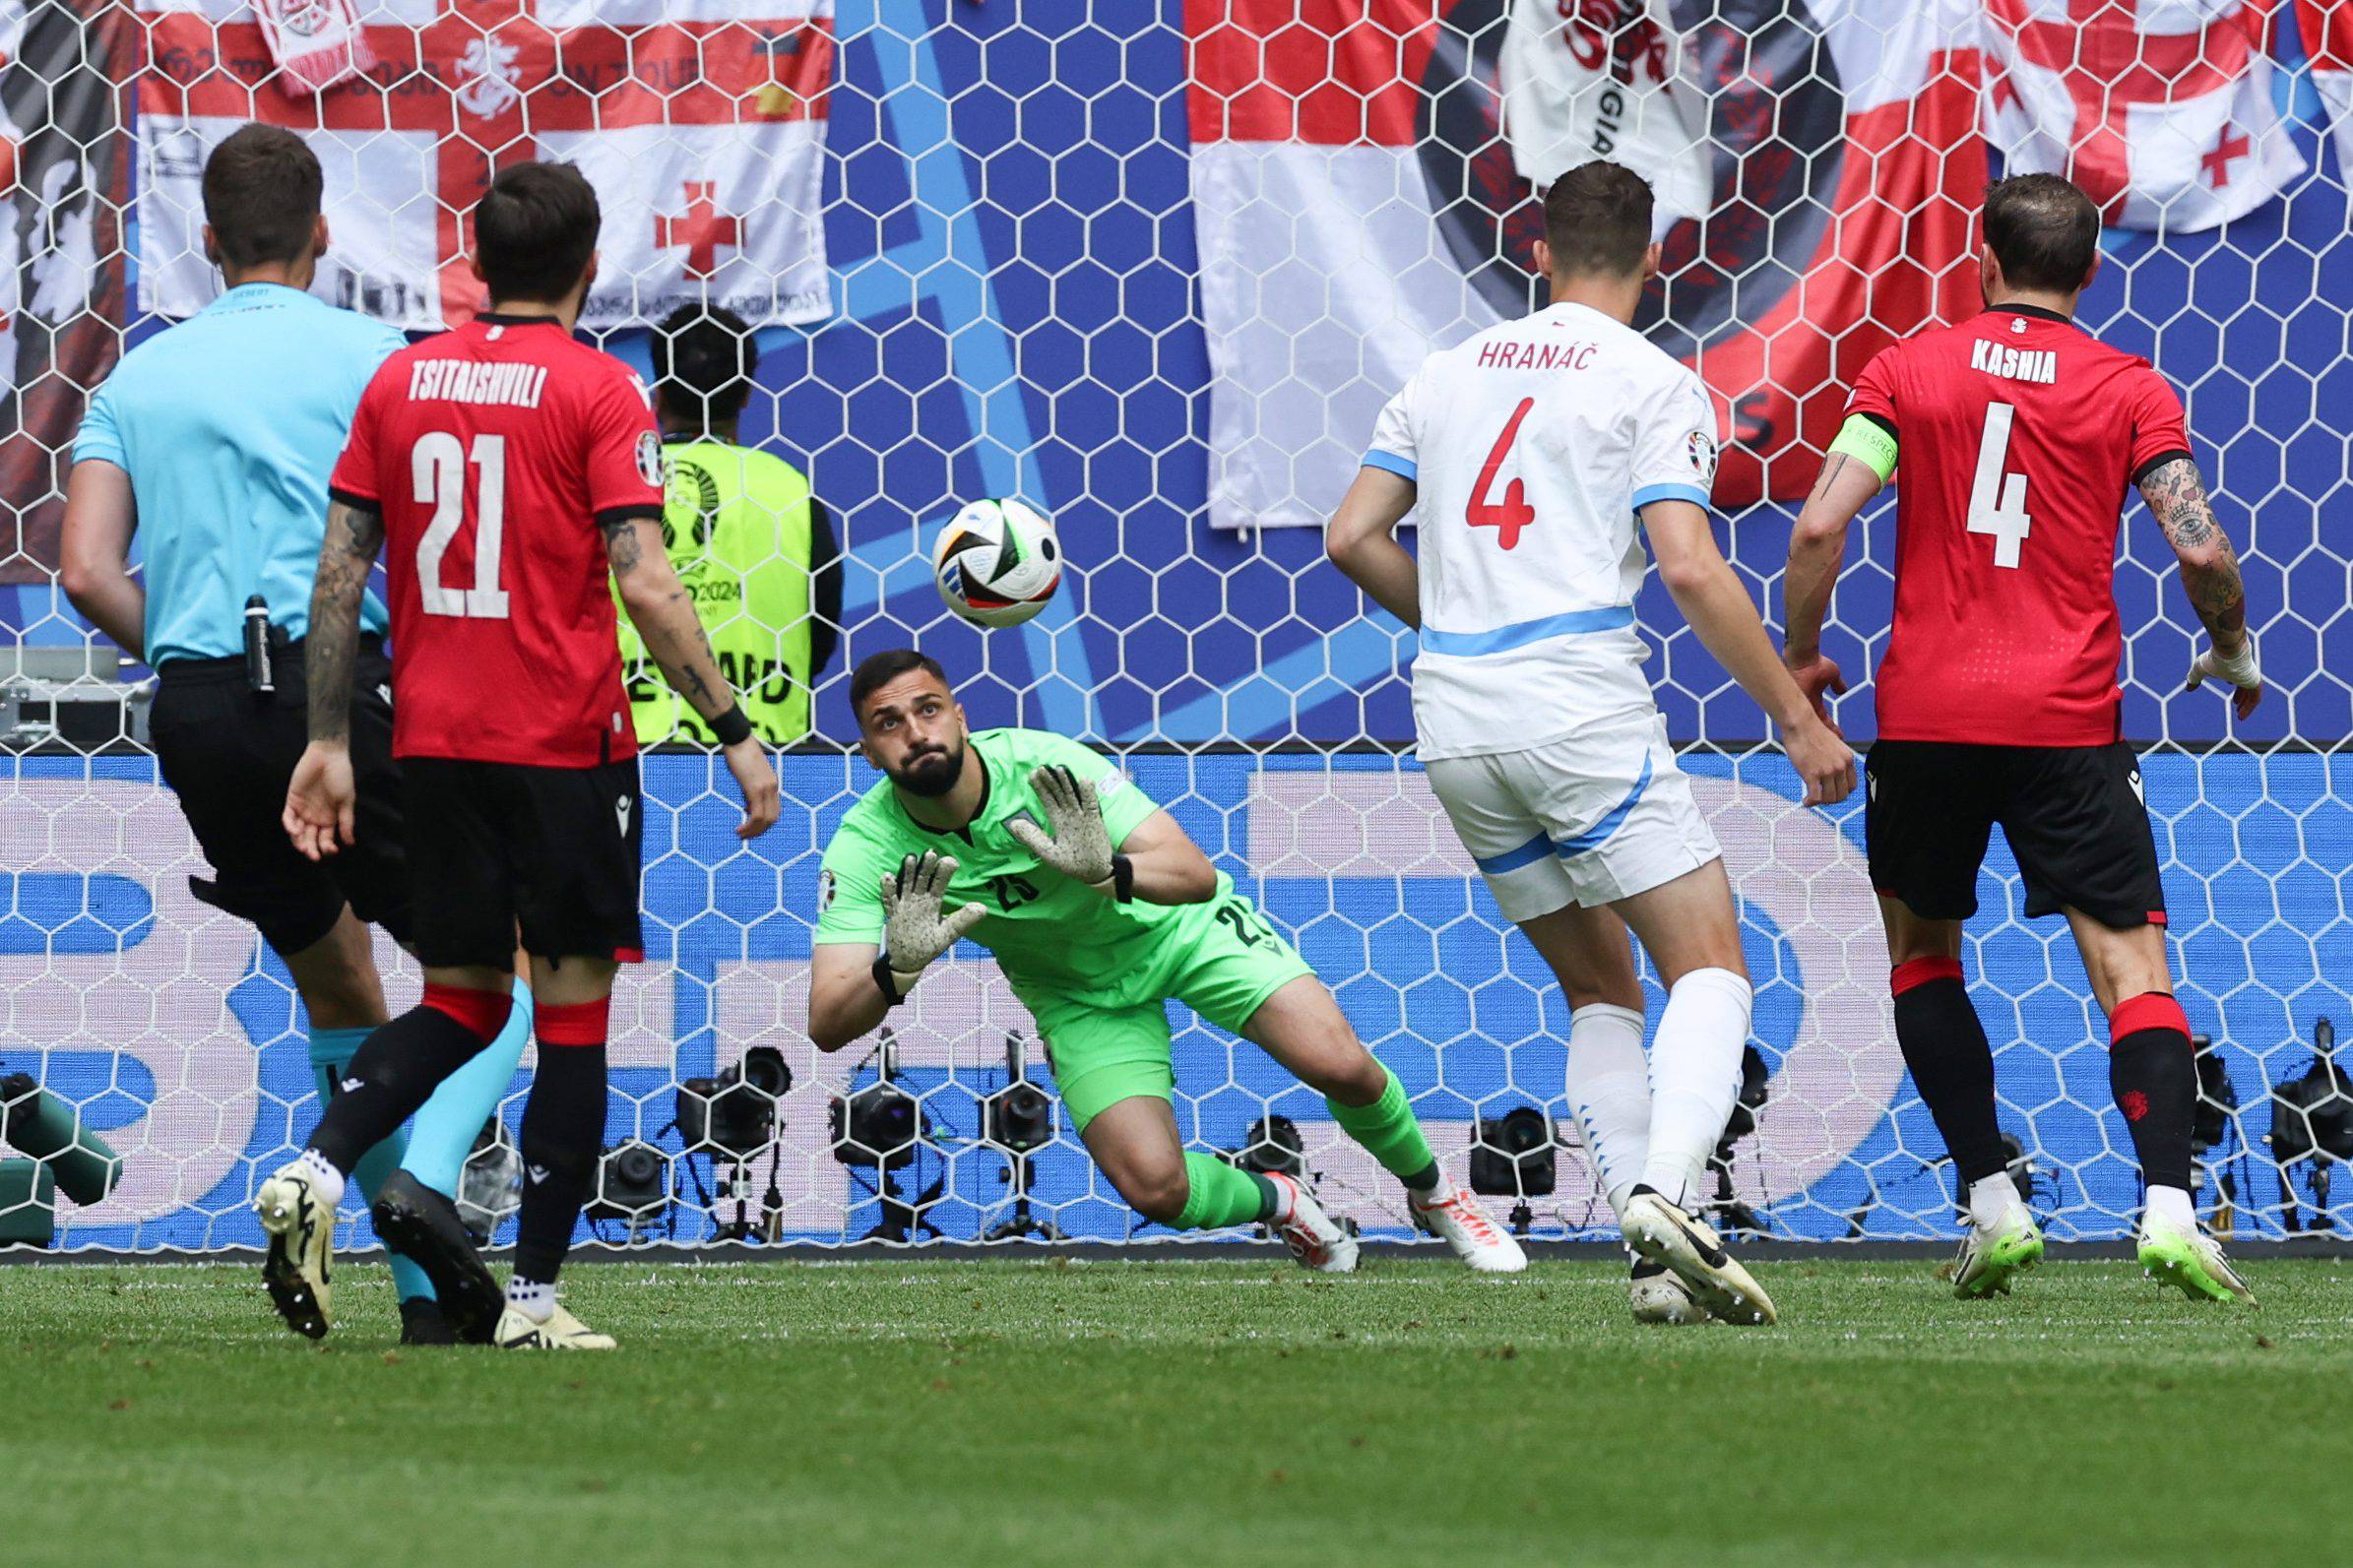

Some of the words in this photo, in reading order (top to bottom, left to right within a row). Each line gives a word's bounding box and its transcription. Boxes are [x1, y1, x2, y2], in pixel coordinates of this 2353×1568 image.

[1477, 341, 1598, 370] HRANÁČ
[1971, 338, 2057, 385] KASHIA
[409, 358, 547, 408] TSITAISHVILI
[1856, 429, 1897, 464] RESPECT
[1466, 397, 1536, 551] 4
[1967, 401, 2031, 569] 4
[412, 431, 510, 618] 21
[985, 874, 1040, 913] 25
[1215, 899, 1274, 948] 2
